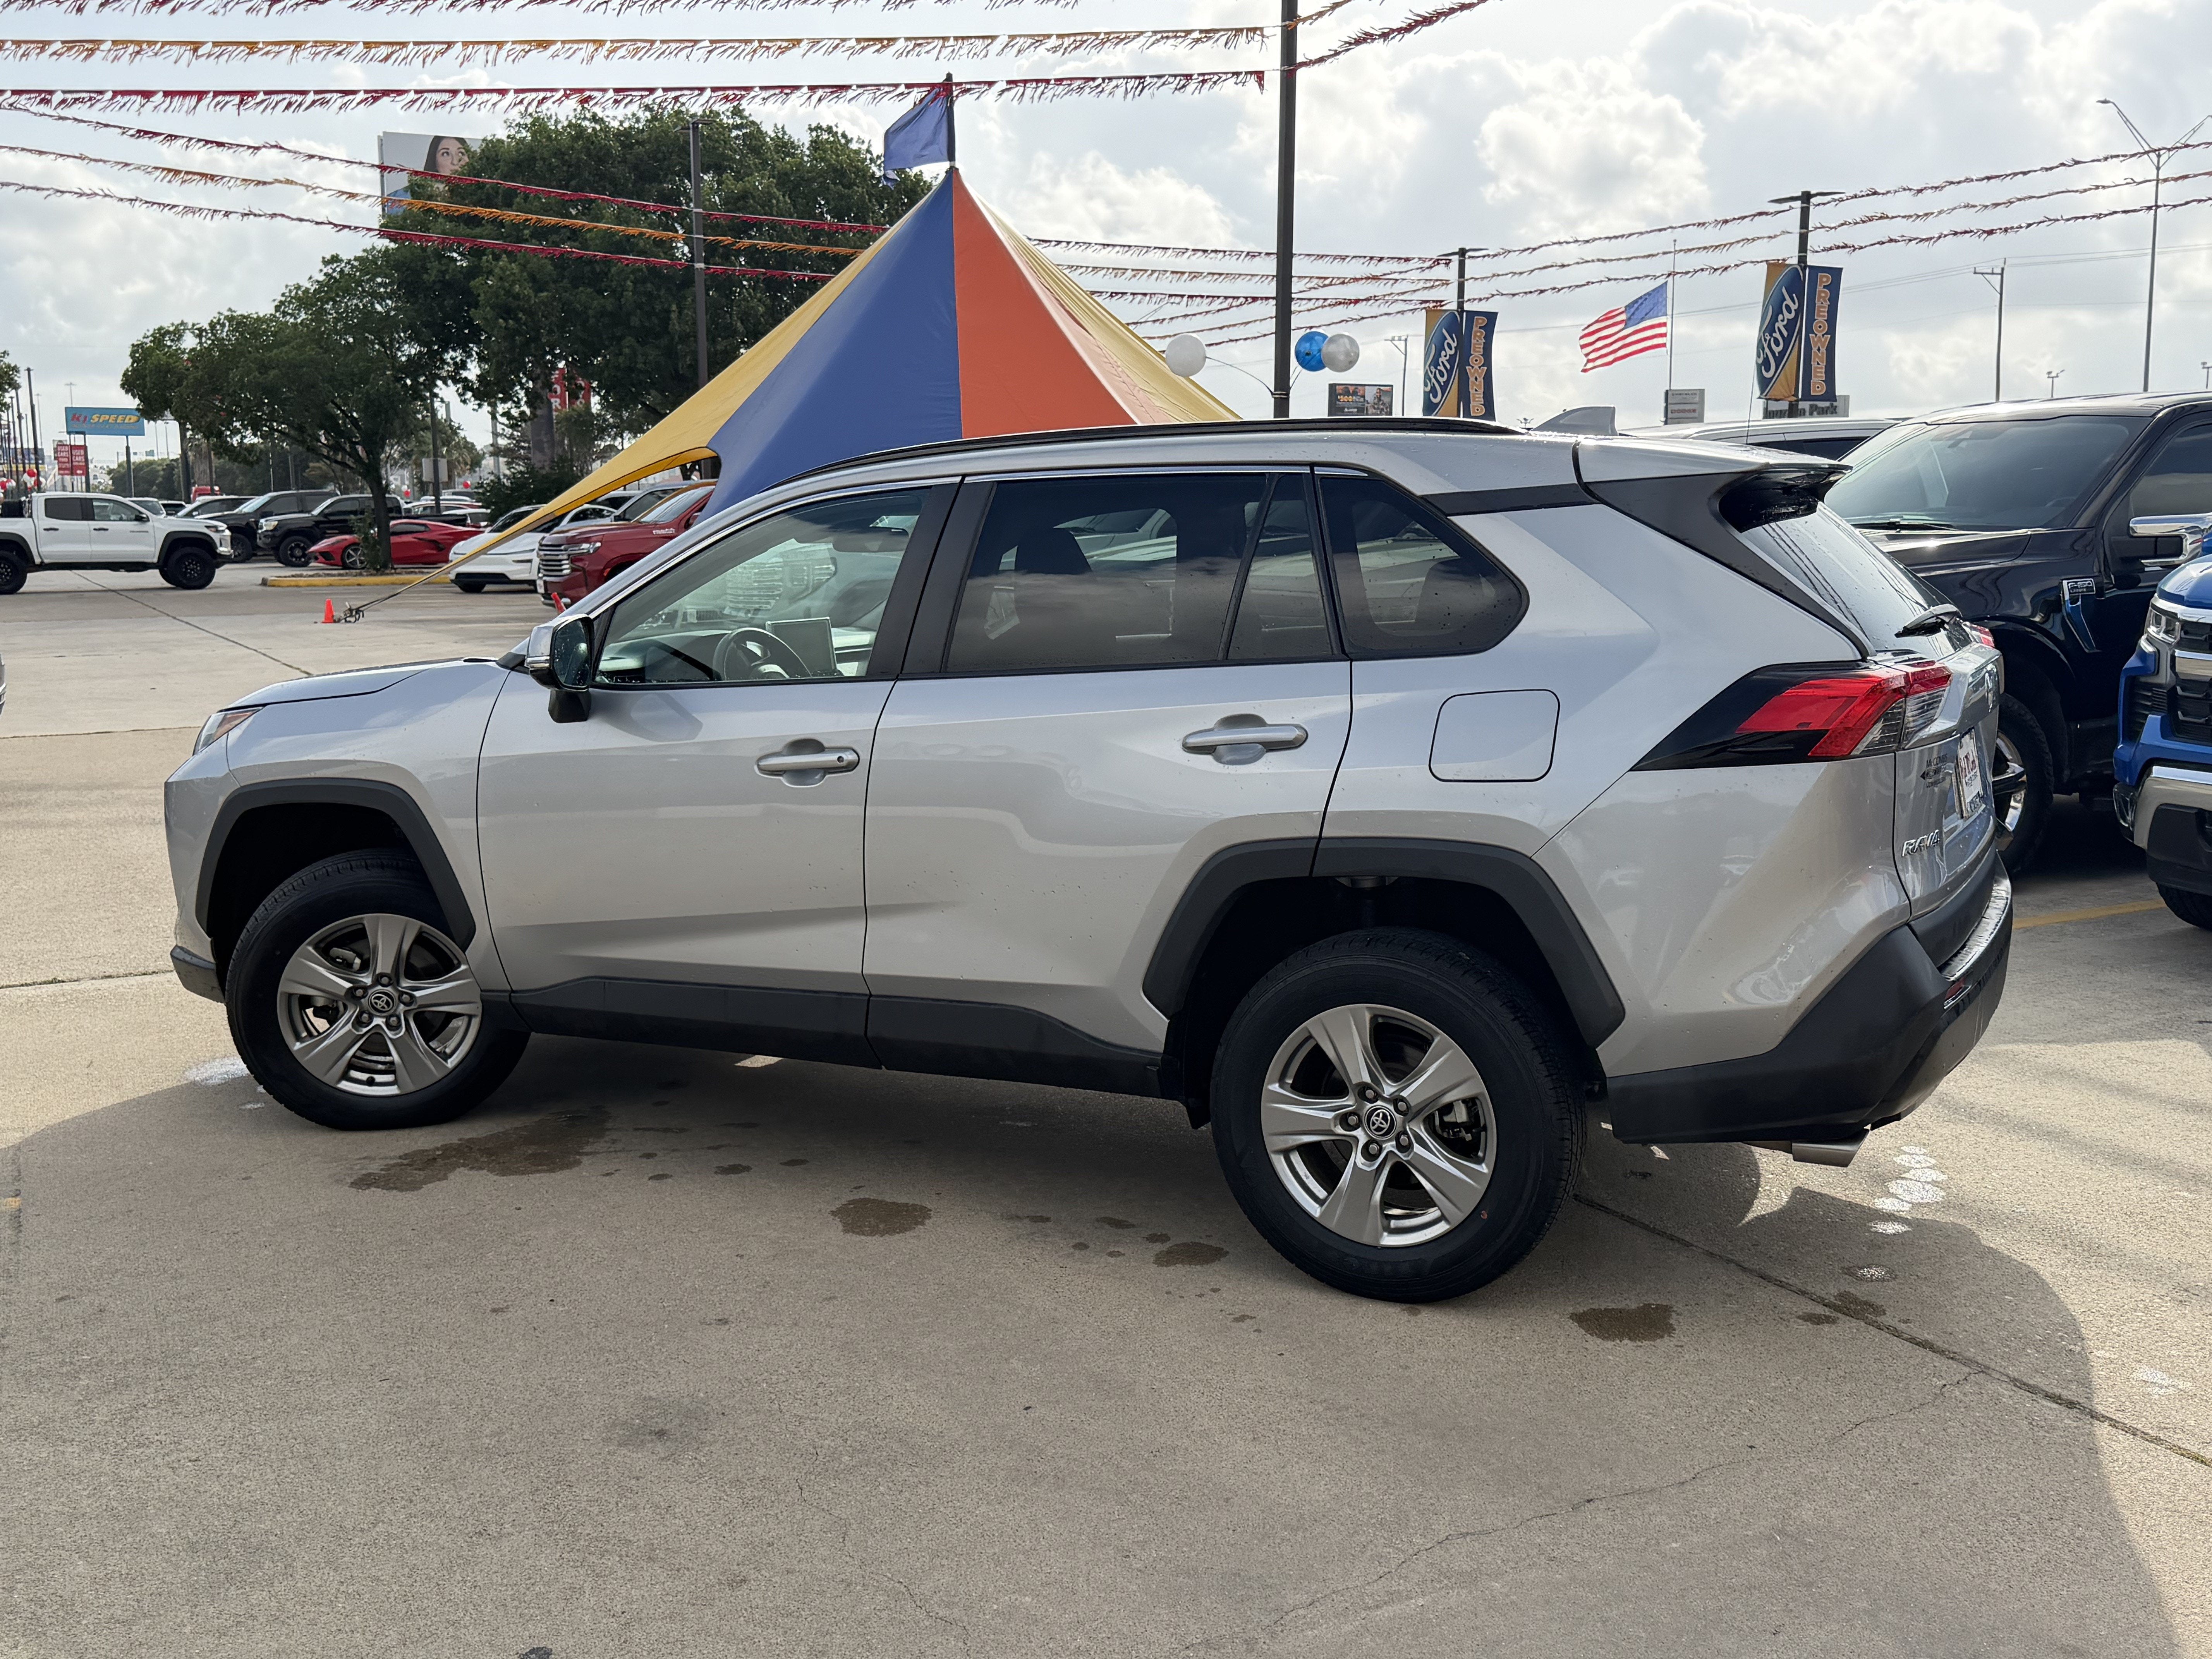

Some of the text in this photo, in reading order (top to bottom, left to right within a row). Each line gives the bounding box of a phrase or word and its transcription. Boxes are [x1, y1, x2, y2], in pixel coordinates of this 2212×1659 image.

[1424, 328, 1457, 403] Ford
[1466, 316, 1487, 416] PREOWNED
[1756, 286, 1798, 378] Ford
[1809, 273, 1831, 395] PREOWNED
[90, 414, 140, 423] SPEED
[1809, 403, 1837, 416] Park
[1902, 830, 1940, 856] RAV4
